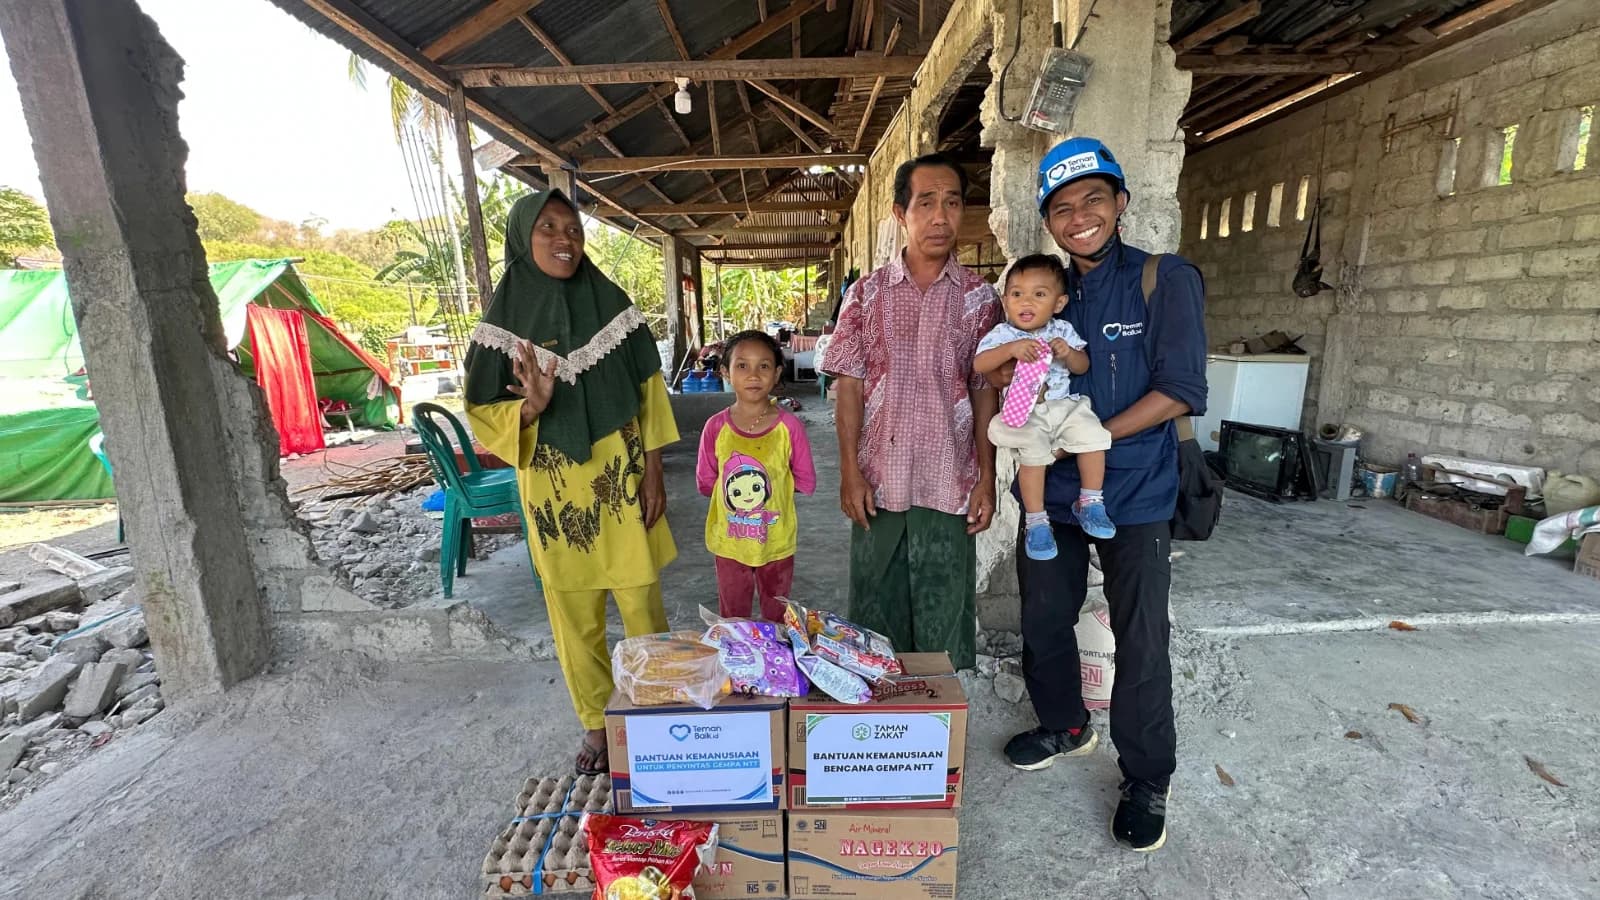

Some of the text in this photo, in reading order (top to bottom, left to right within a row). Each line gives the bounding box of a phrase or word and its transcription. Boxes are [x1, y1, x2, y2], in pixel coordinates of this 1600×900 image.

[1081, 667, 1103, 684] SNI
[926, 689, 938, 698] 2
[693, 725, 722, 733] Teman
[874, 724, 908, 732] TAMAN
[874, 732, 905, 740] ZAKAT
[635, 751, 759, 762] BANTUAN KEMANUSIAAN
[813, 750, 943, 760] BANTUAN KEMANUSIAAN
[636, 760, 759, 771] UNTUK PENYINTAS GEMPA NTT
[824, 763, 934, 773] BENCANA GEMPA NTT
[849, 823, 891, 834] Air Mineral
[840, 839, 944, 857] NAGEKEO
